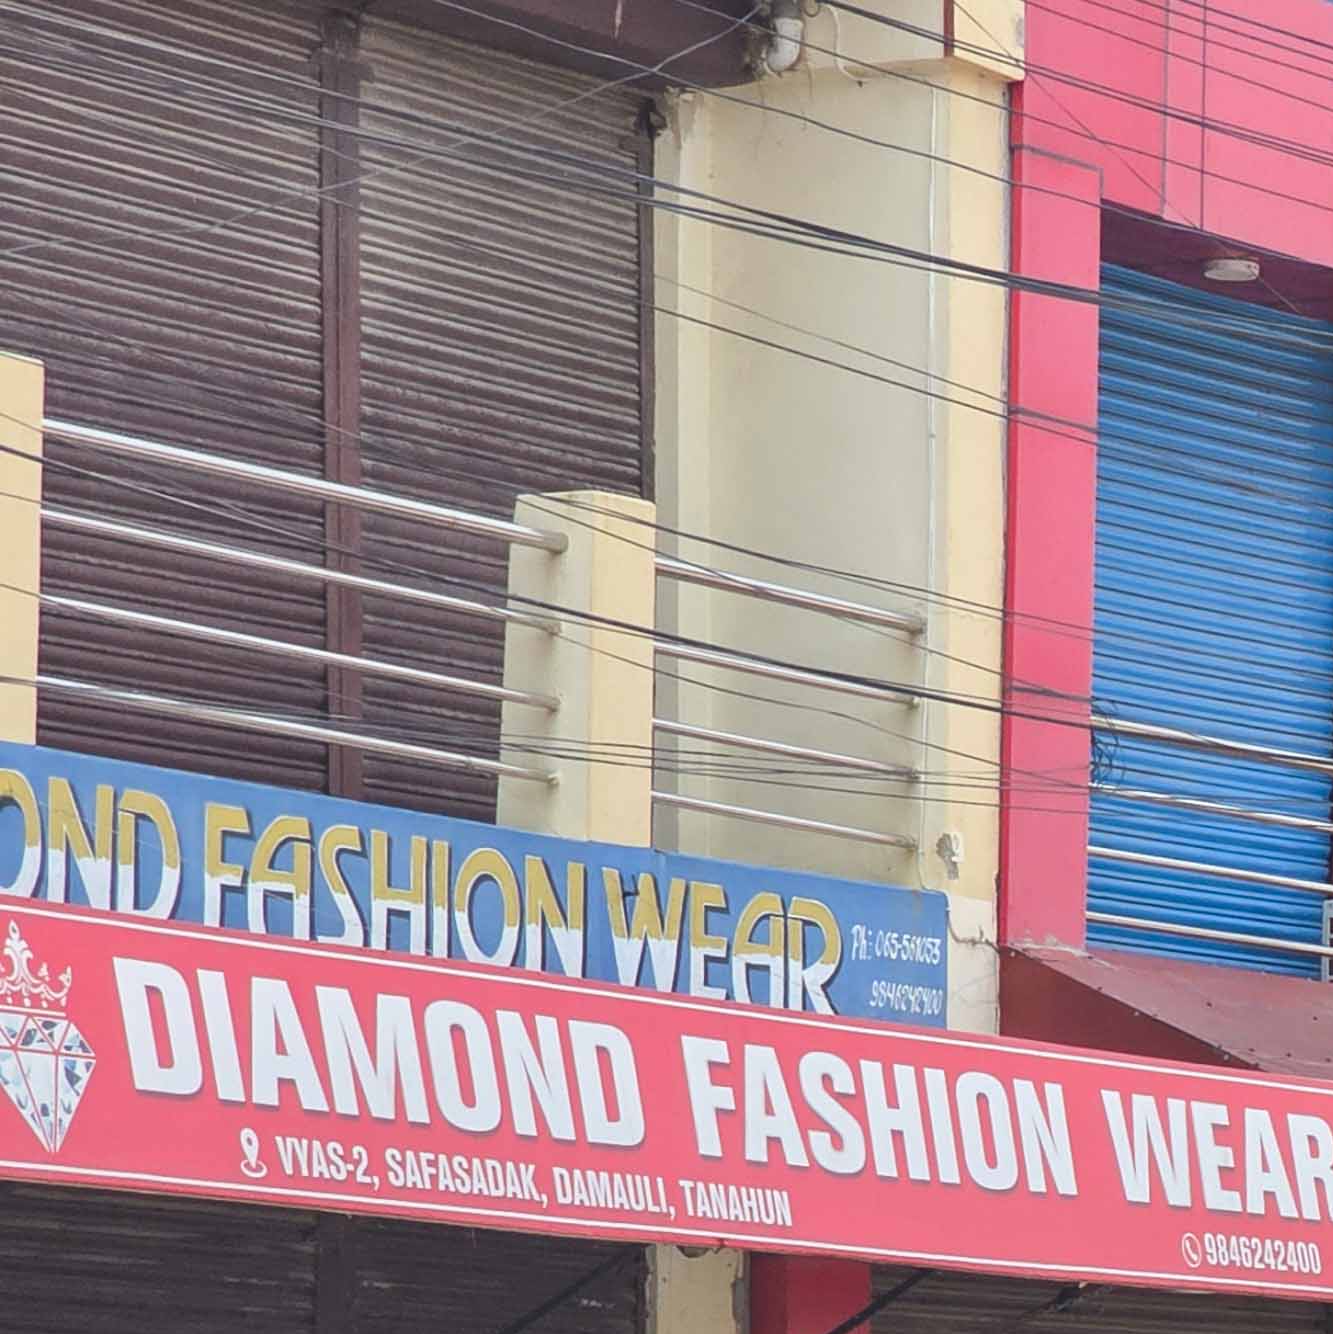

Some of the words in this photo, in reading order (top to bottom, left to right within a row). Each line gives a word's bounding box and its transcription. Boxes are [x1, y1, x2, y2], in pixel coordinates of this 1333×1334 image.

[203, 800, 586, 976] FASHION
[602, 866, 843, 1018] WEAR
[112, 956, 645, 1148] DIAMOND
[681, 1034, 1078, 1196] FASHION
[276, 1135, 379, 1192] VYAS-2,
[386, 1148, 548, 1208] SAFASADAK,
[554, 1166, 676, 1221] DAMAULI,
[680, 1179, 793, 1227] TANAHUN
[1204, 1233, 1321, 1275] 9846242400
